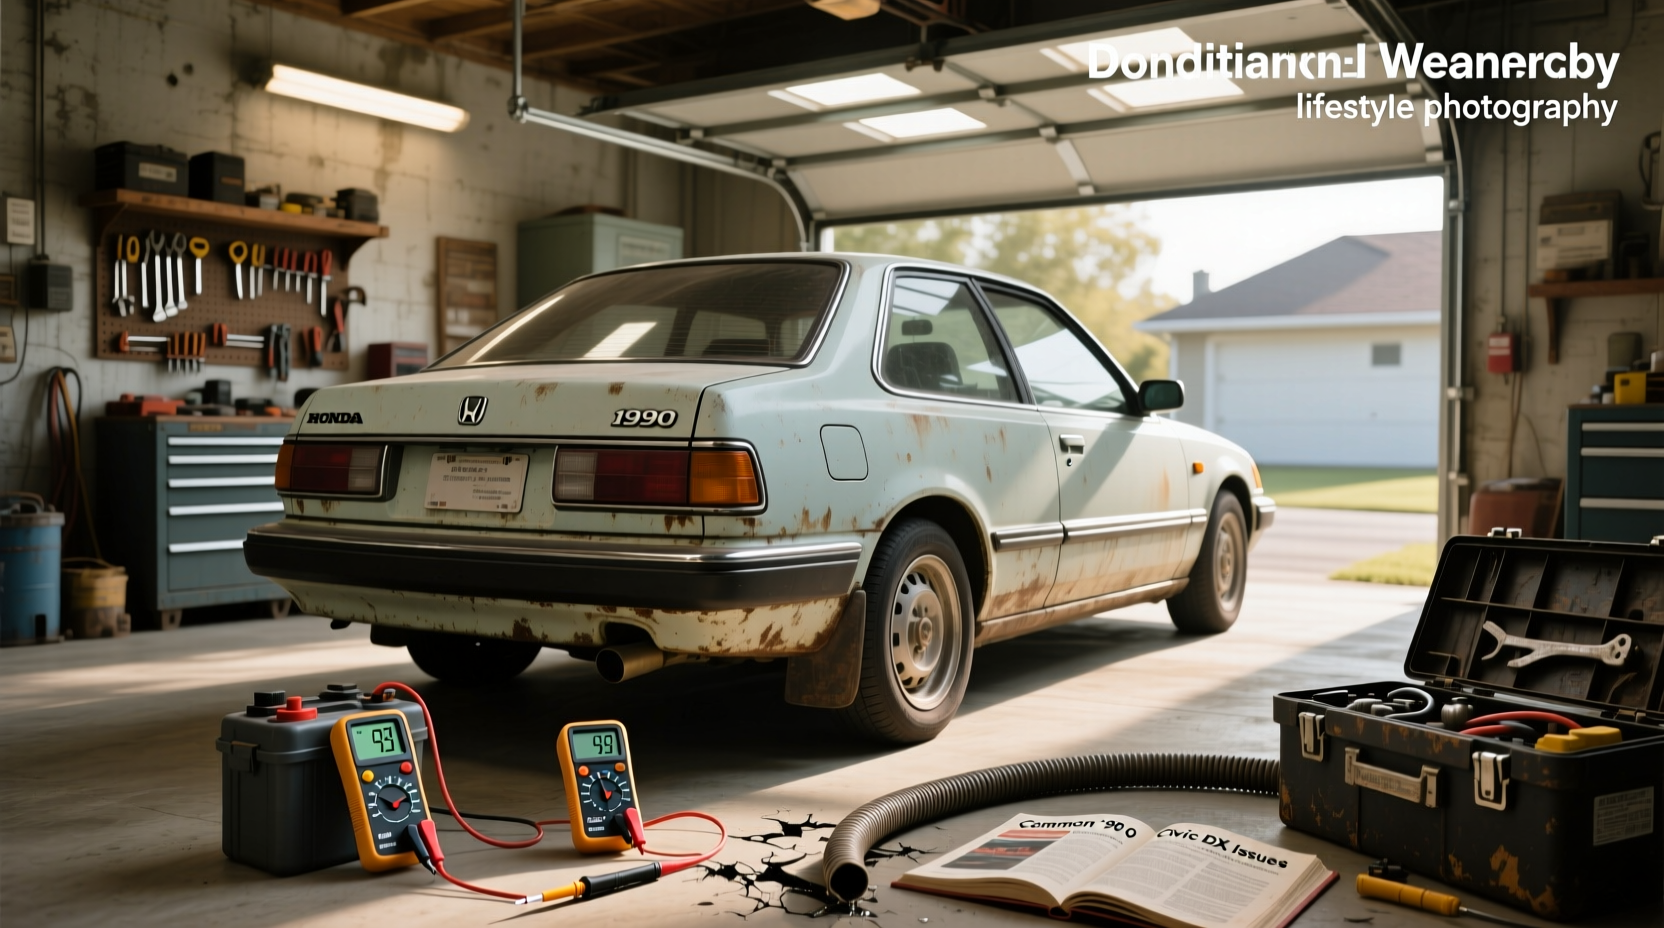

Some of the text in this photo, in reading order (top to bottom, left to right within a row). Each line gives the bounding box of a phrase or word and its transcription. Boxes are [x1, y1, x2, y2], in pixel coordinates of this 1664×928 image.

[307, 412, 363, 424] HONDA
[611, 409, 678, 428] 1990
[593, 735, 613, 754] 99
[1019, 820, 1096, 829] Common
[1201, 834, 1230, 851] DX
[1232, 844, 1288, 868] Issues
